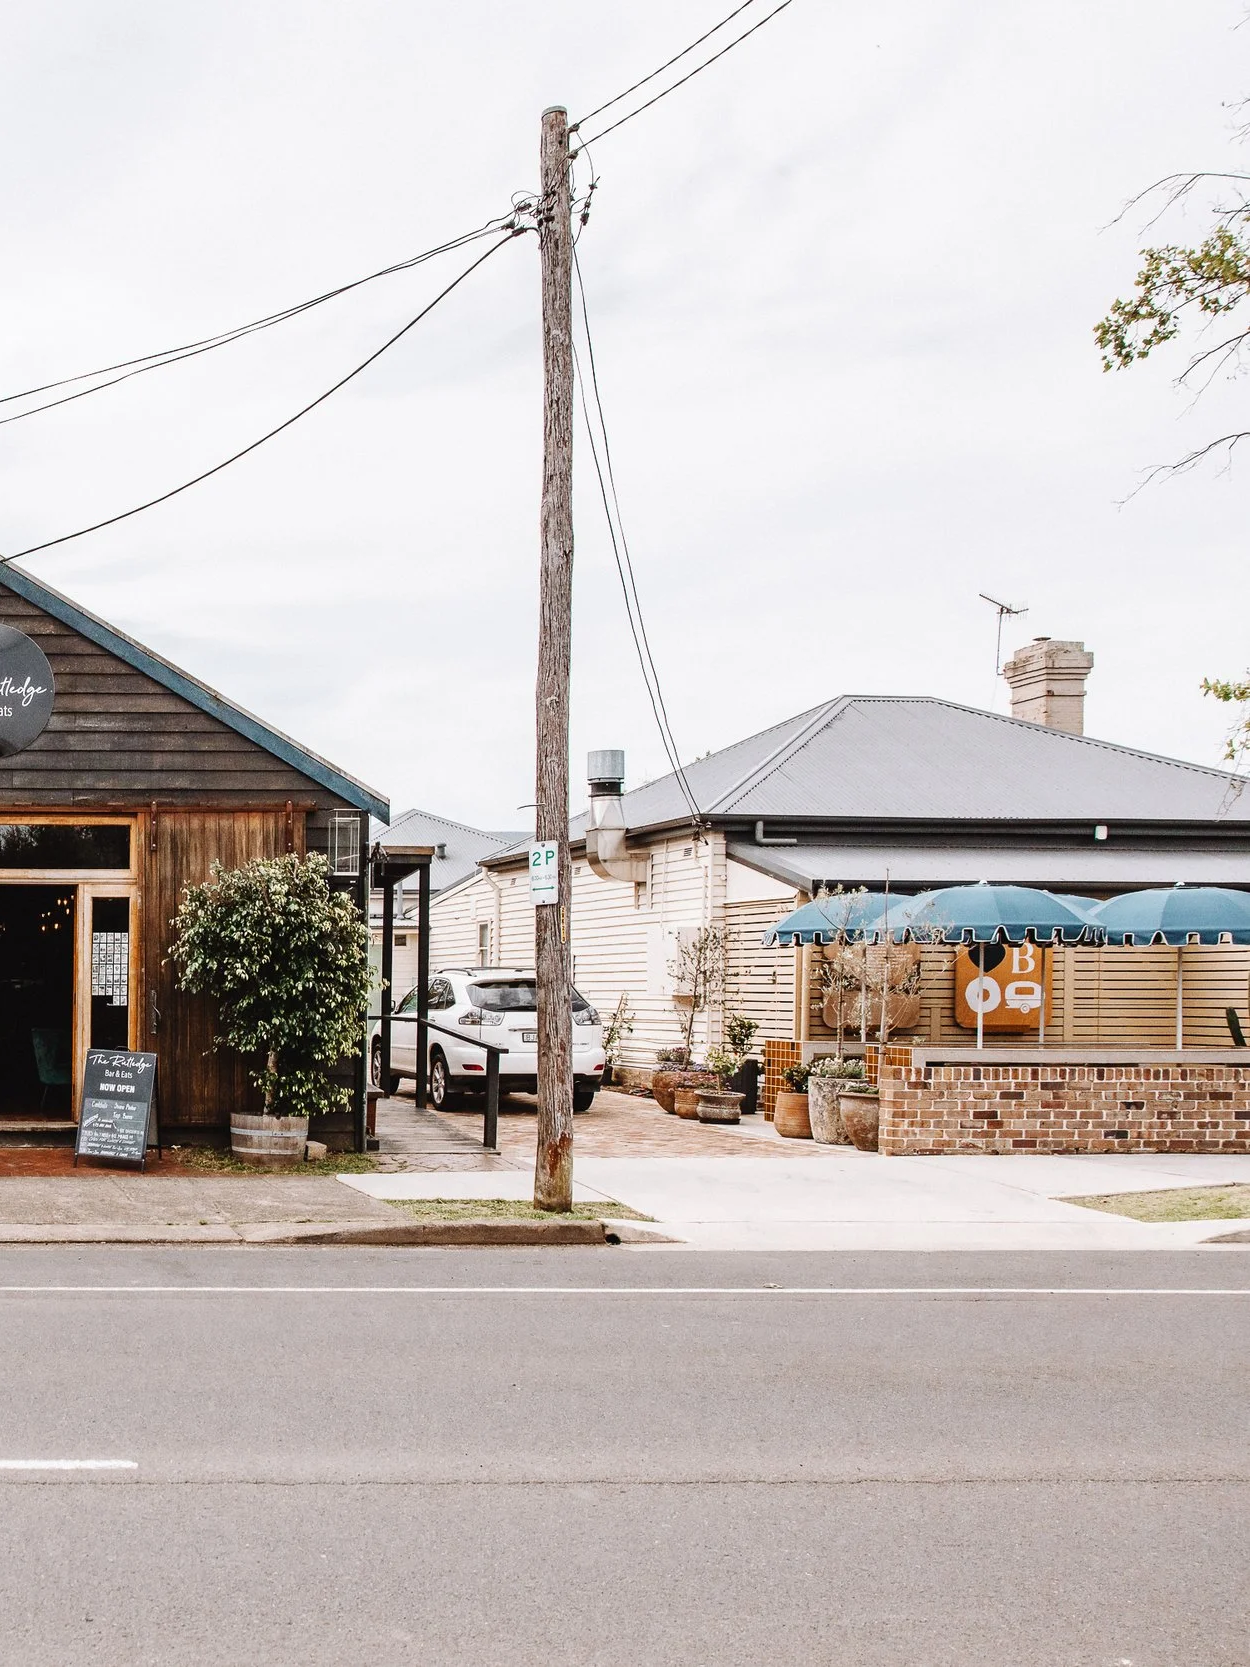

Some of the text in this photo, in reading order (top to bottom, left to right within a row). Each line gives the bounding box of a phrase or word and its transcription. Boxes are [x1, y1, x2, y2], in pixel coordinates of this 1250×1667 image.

[88, 1053, 152, 1074] The Rutledge
[104, 1069, 115, 1077] Bar
[121, 1070, 133, 1079] Eats
[99, 1083, 136, 1094] NOW OPEN
